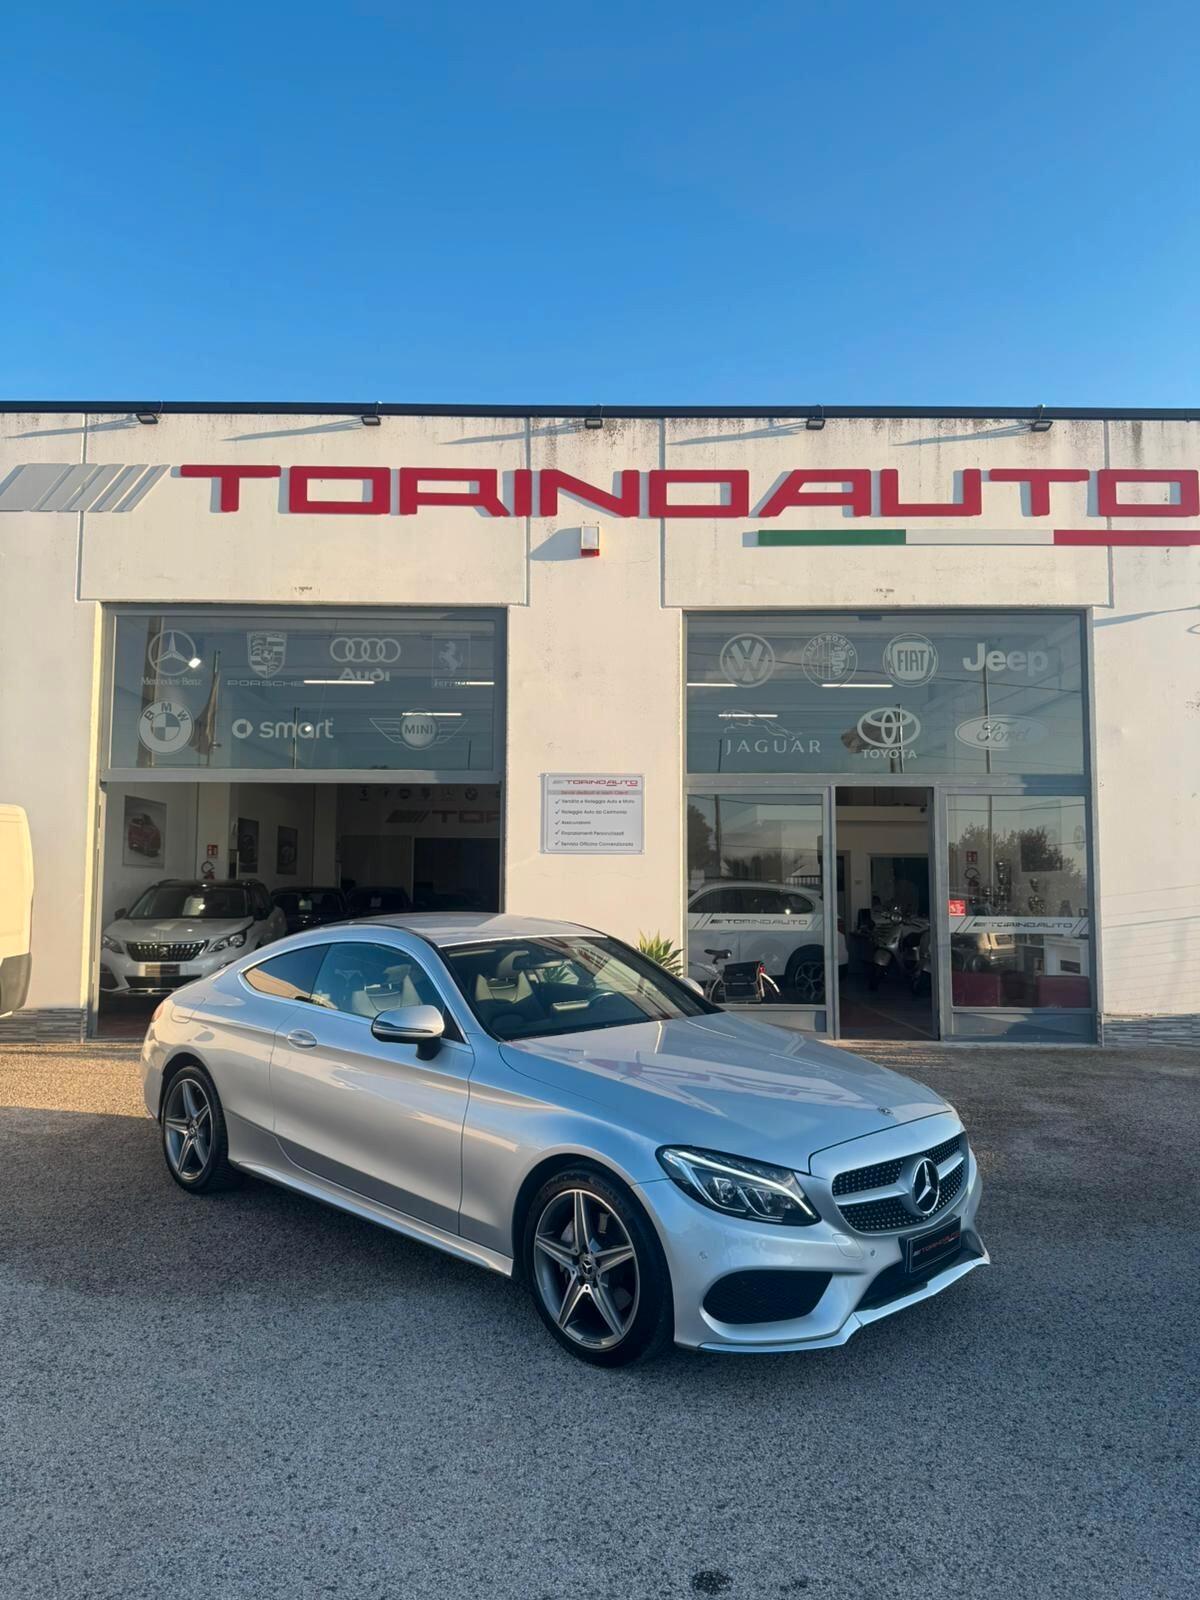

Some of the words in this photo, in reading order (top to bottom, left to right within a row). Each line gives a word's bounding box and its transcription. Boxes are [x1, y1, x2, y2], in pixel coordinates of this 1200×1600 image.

[180, 464, 1199, 518] TORINOAUTO
[806, 637, 824, 656] ALFA
[825, 635, 855, 657] ROMEO
[897, 650, 926, 672] FIAT
[962, 643, 1048, 677] Jeep
[227, 679, 305, 687] PORSCHE
[339, 667, 391, 682] Audi
[259, 719, 333, 739] smart
[405, 724, 433, 735] MINI
[976, 721, 1031, 742] Ford
[726, 740, 821, 755] JAGUAR
[862, 749, 917, 759] TOYOTA
